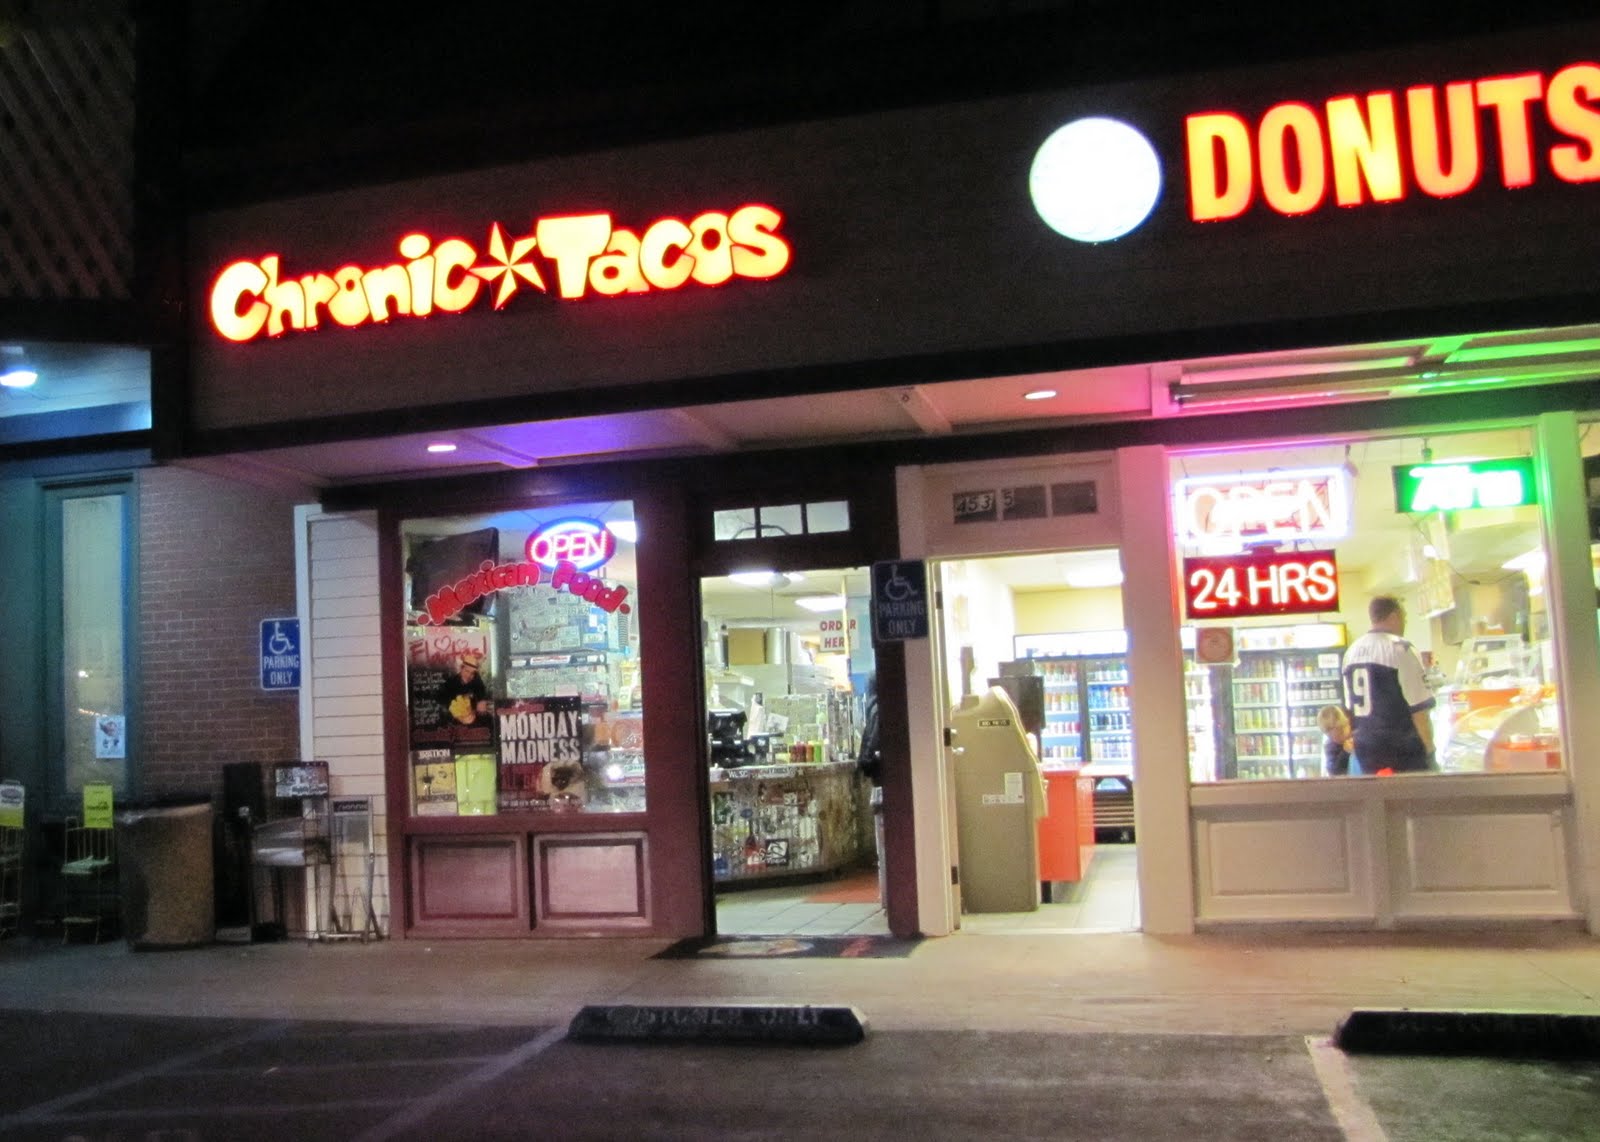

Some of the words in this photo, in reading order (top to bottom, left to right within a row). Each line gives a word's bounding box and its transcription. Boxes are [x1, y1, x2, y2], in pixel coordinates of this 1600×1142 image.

[1184, 61, 1600, 222] DONUTS
[209, 229, 481, 343] Chronic
[536, 205, 790, 300] Tacos
[1190, 477, 1337, 540] OPEN
[530, 531, 608, 562] OPEN
[1190, 568, 1241, 608] 24
[1248, 561, 1336, 606] HRS
[878, 600, 924, 617] PARKING
[820, 619, 857, 632] ORDR
[888, 619, 916, 634] ONLY
[824, 636, 851, 649] HER
[263, 655, 300, 670] PARKING
[270, 671, 293, 685] ONLY
[500, 711, 578, 741] MONDAY
[501, 738, 580, 765] MADNESS
